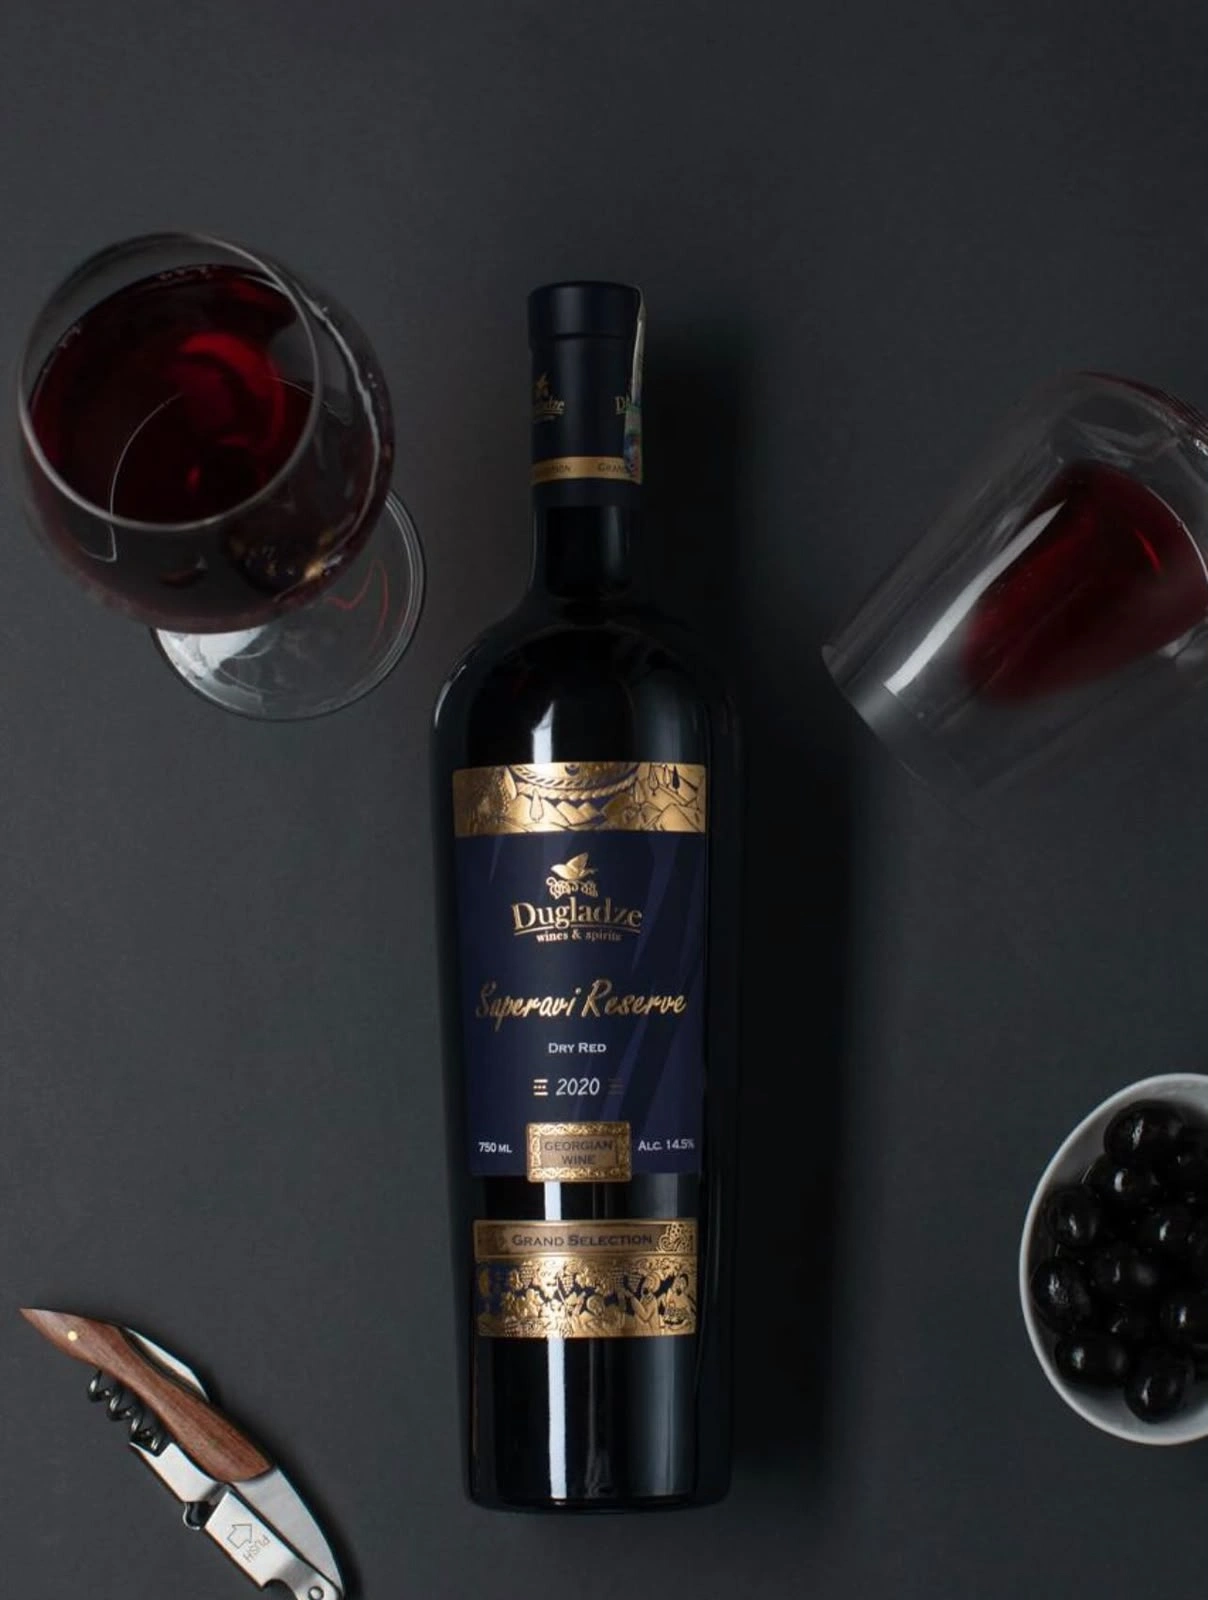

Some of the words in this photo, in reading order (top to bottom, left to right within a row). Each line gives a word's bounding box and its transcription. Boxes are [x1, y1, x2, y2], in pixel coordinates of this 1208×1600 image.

[511, 896, 643, 930] Dugladze
[536, 932, 568, 942] wines
[571, 929, 582, 940] &
[581, 979, 688, 1018] Reserve
[555, 1077, 601, 1096] 2020
[479, 1141, 497, 1153] 750
[544, 1140, 613, 1151] GEORGIAN
[562, 1154, 597, 1165] WINE
[511, 1234, 565, 1247] GRAND
[568, 1234, 653, 1247] SELECTION
[242, 1533, 271, 1563] PUSH
